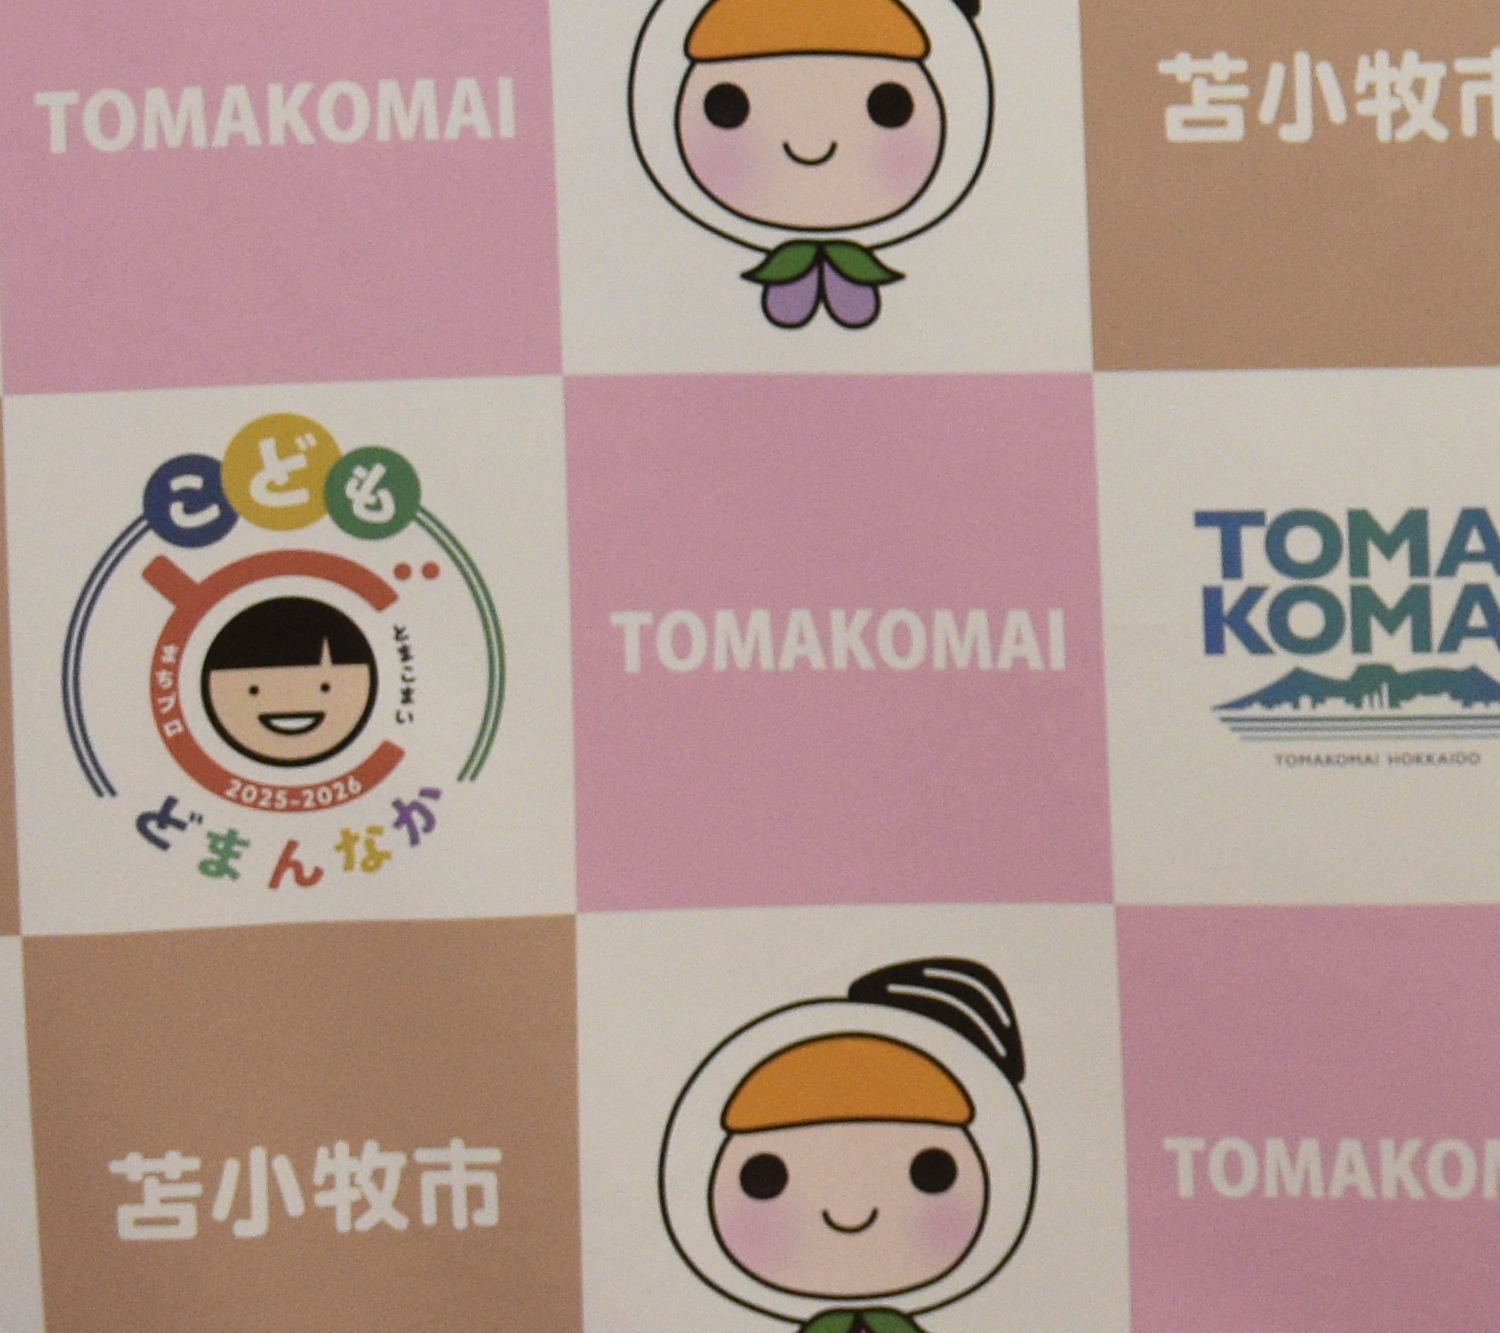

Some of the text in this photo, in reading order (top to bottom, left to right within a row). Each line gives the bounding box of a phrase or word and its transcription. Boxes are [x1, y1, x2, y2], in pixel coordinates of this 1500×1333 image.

[35, 77, 516, 153] TOMAKOMAI
[168, 433, 396, 525] こども
[610, 608, 1066, 673] TOMAKOMAI
[222, 776, 363, 811] 2025-2026
[1274, 752, 1481, 770] TOMAKOMAI HOKKAIDO
[137, 789, 444, 890] どまんなか
[109, 1138, 502, 1240] 苫小牧市
